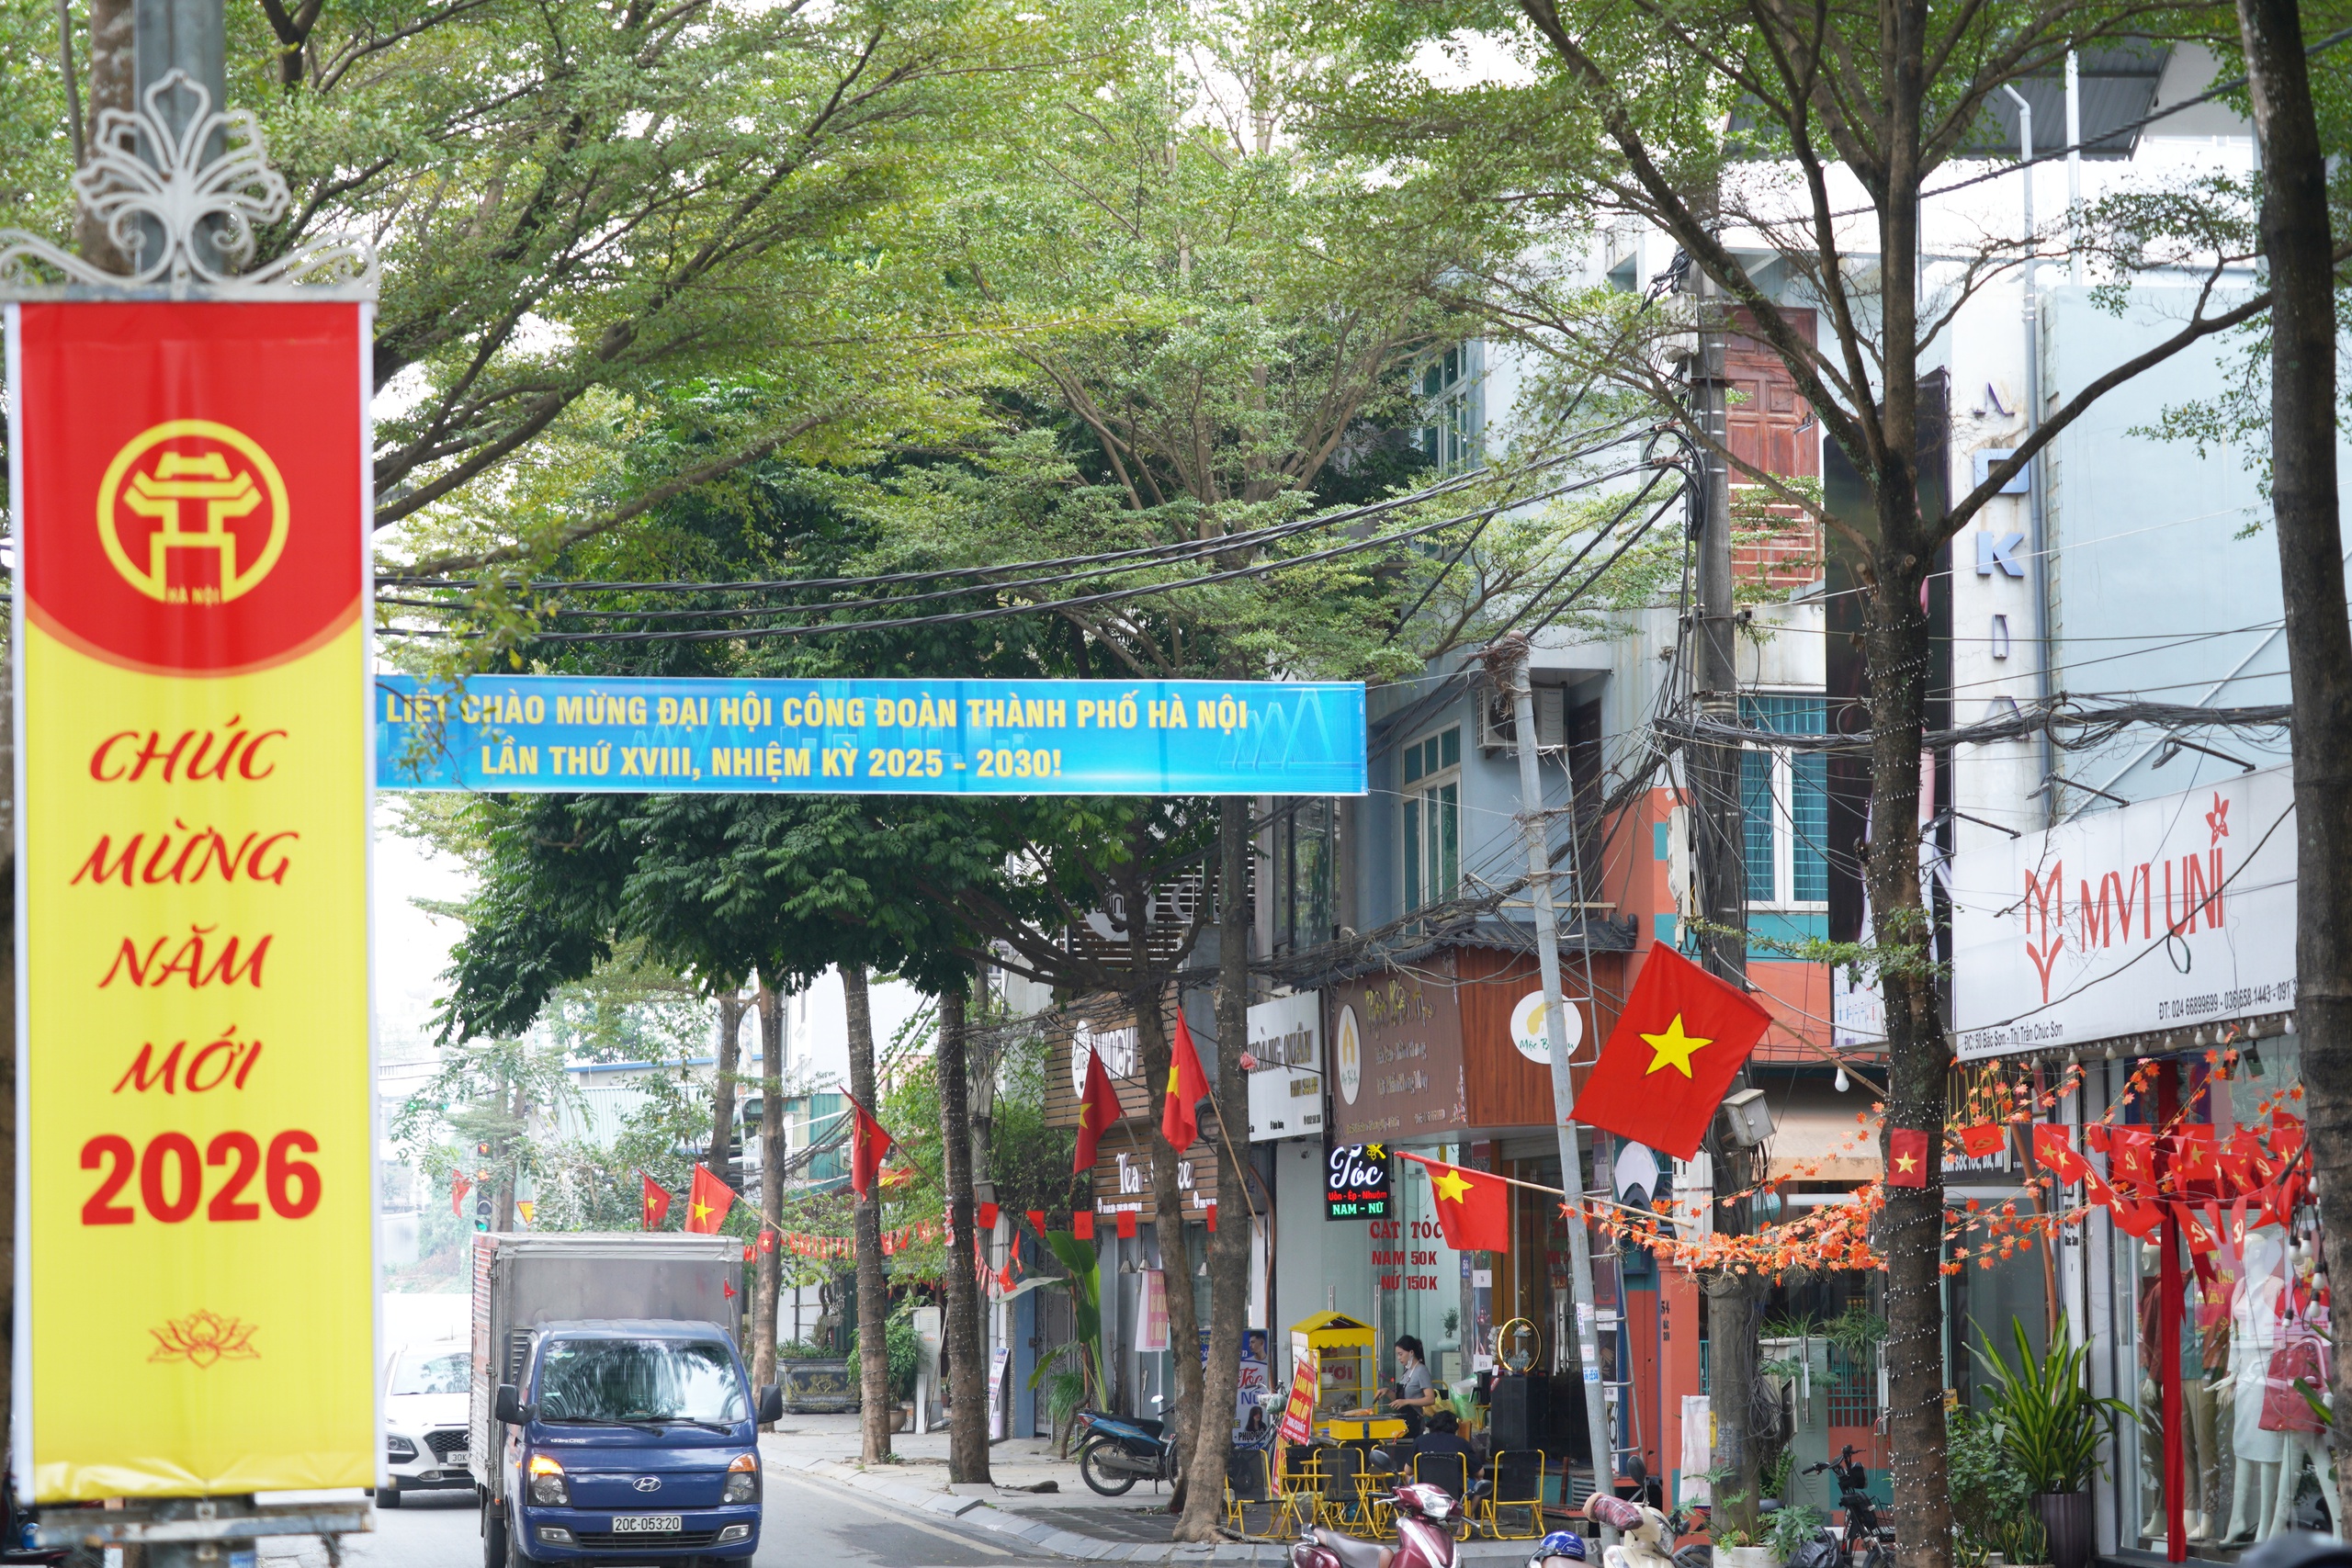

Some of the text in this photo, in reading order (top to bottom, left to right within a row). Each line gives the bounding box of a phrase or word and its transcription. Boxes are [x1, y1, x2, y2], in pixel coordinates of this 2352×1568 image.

[461, 689, 545, 724] CHÀO
[557, 689, 647, 725] MỪNG
[657, 696, 708, 732] ĐẠI
[720, 691, 772, 732] HỘI
[783, 692, 865, 727] CÔNG
[875, 692, 956, 728] ĐOÀN
[967, 693, 1066, 728] THÀNH
[1078, 690, 1138, 728] PHỐ
[1148, 694, 1188, 728] HÀ
[1198, 694, 1248, 735] NỘI
[89, 714, 287, 784] CHÚC
[481, 736, 537, 774] LẦN
[549, 739, 612, 775] THỨ
[620, 747, 701, 781] XVIII,
[712, 741, 810, 783] NHIỆM
[822, 741, 859, 776] KỲ
[868, 749, 943, 777] 2025
[977, 749, 1061, 777] 2030!
[70, 818, 298, 886] MỪNG
[2165, 847, 2223, 938] UNI
[97, 922, 273, 989] NĂM
[2159, 1002, 2170, 1020] ĐT:
[2172, 998, 2184, 1018] 024
[2186, 993, 2218, 1015] 66899699
[2224, 989, 2237, 1010] 036
[2239, 987, 2251, 1008] 658
[2254, 983, 2270, 1005] 1443
[2278, 981, 2290, 1001] 091
[1283, 1021, 1313, 1074] QUÂN
[1975, 1033, 1982, 1048] 50
[1983, 1028, 1993, 1048] Bắc
[1995, 1031, 2006, 1046] Sơn
[2010, 1027, 2019, 1046] Thị
[2020, 1021, 2032, 1043] Trấn
[2034, 1021, 2049, 1040] Chúc
[2051, 1021, 2063, 1037] Sơn
[111, 1023, 262, 1095] MỚI
[81, 1130, 322, 1225] 2026
[1115, 1152, 1140, 1193] Tea
[1330, 1144, 1383, 1189] Tóc
[1333, 1203, 1357, 1214] NAM
[1410, 1214, 1442, 1239] TÓC
[1372, 1251, 1437, 1265] NAM 50K
[1381, 1270, 1438, 1290] NỮ 150K
